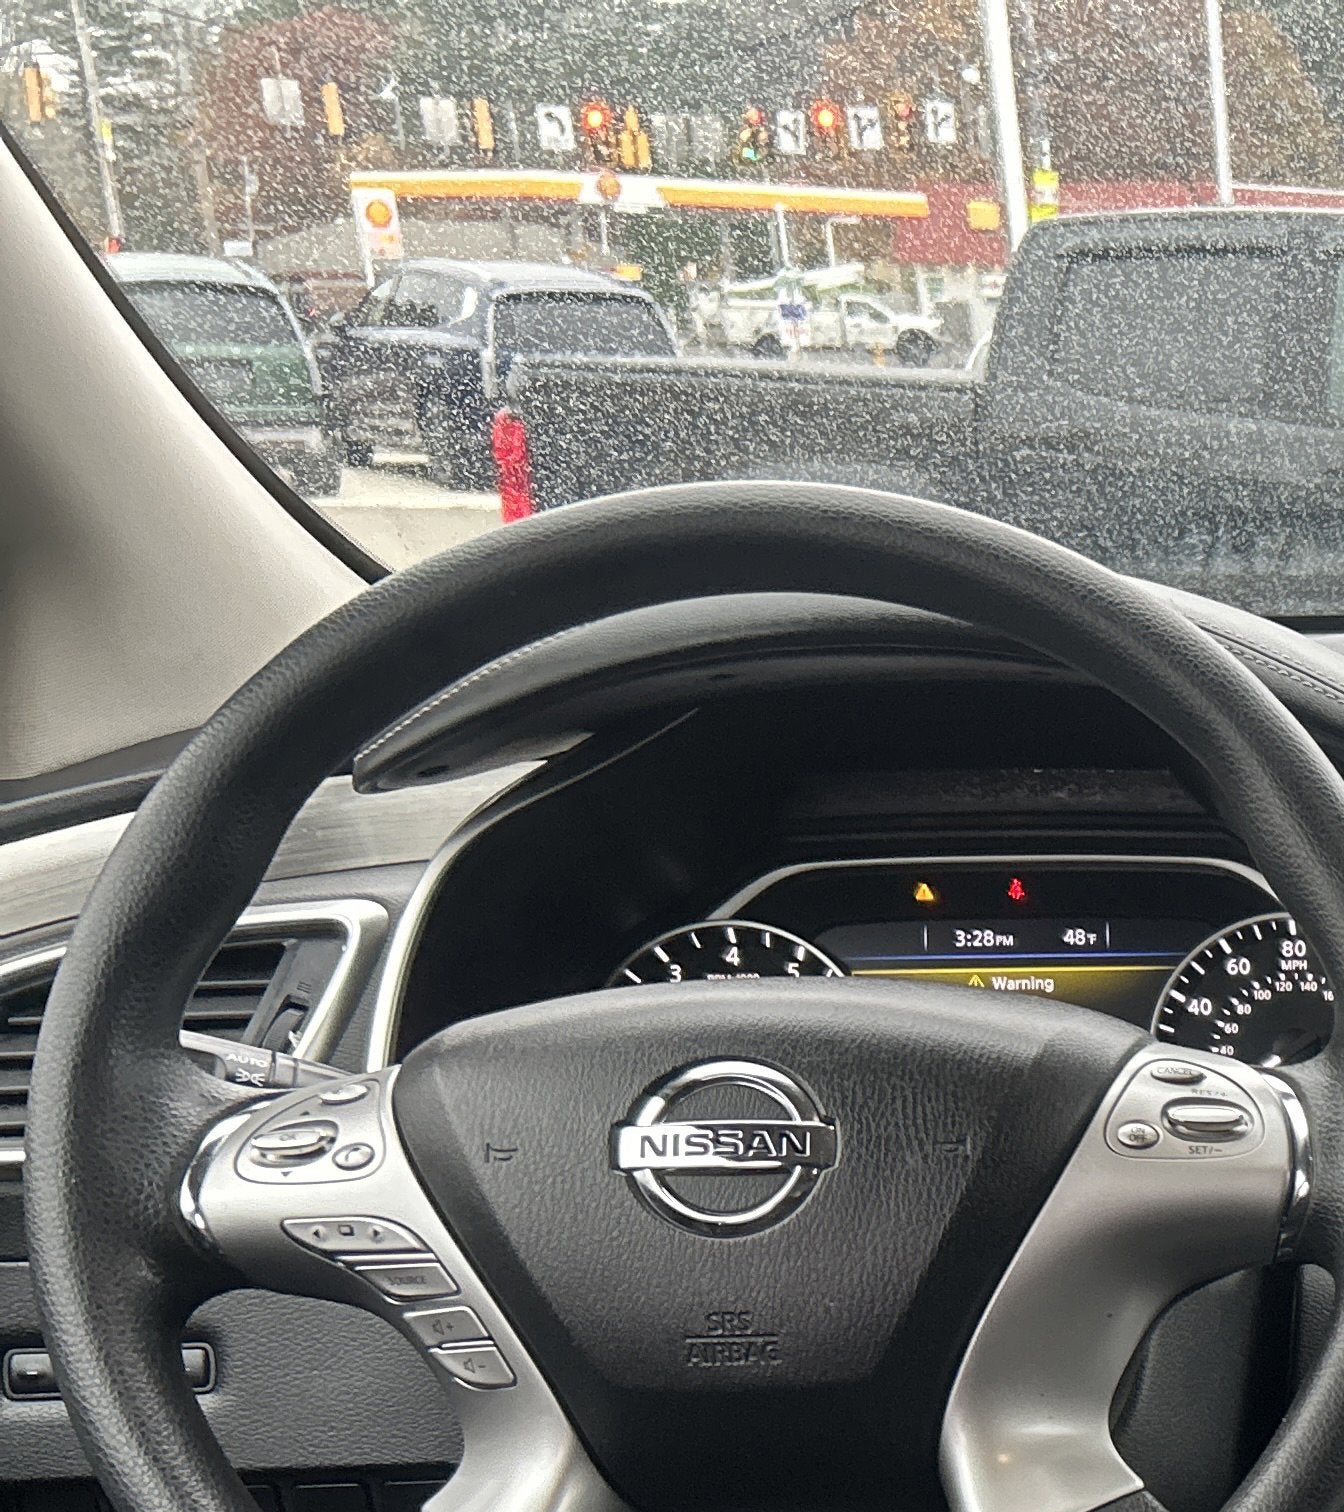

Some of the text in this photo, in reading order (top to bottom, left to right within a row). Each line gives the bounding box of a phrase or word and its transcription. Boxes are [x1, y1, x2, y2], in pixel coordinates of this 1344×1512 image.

[725, 946, 741, 966] 4
[1281, 940, 1307, 957] 80
[787, 962, 800, 978] 5
[1226, 958, 1251, 975] 60
[1280, 960, 1308, 971] MPH
[669, 964, 682, 983] 3
[992, 974, 1055, 993] Warning
[1275, 981, 1293, 992] 120
[1300, 981, 1318, 992] 140
[1253, 989, 1272, 1001] 100
[1322, 990, 1335, 1001] 16
[1187, 998, 1212, 1016] 40
[1236, 1004, 1252, 1015] 80
[1224, 1022, 1239, 1034] 60
[1220, 1045, 1235, 1056] 40
[226, 1053, 267, 1068] AUTO
[1157, 1066, 1193, 1075] CANCEL
[640, 1130, 811, 1159] NISSAN
[704, 1311, 752, 1334] SRS
[686, 1342, 782, 1367] AIRBAG
